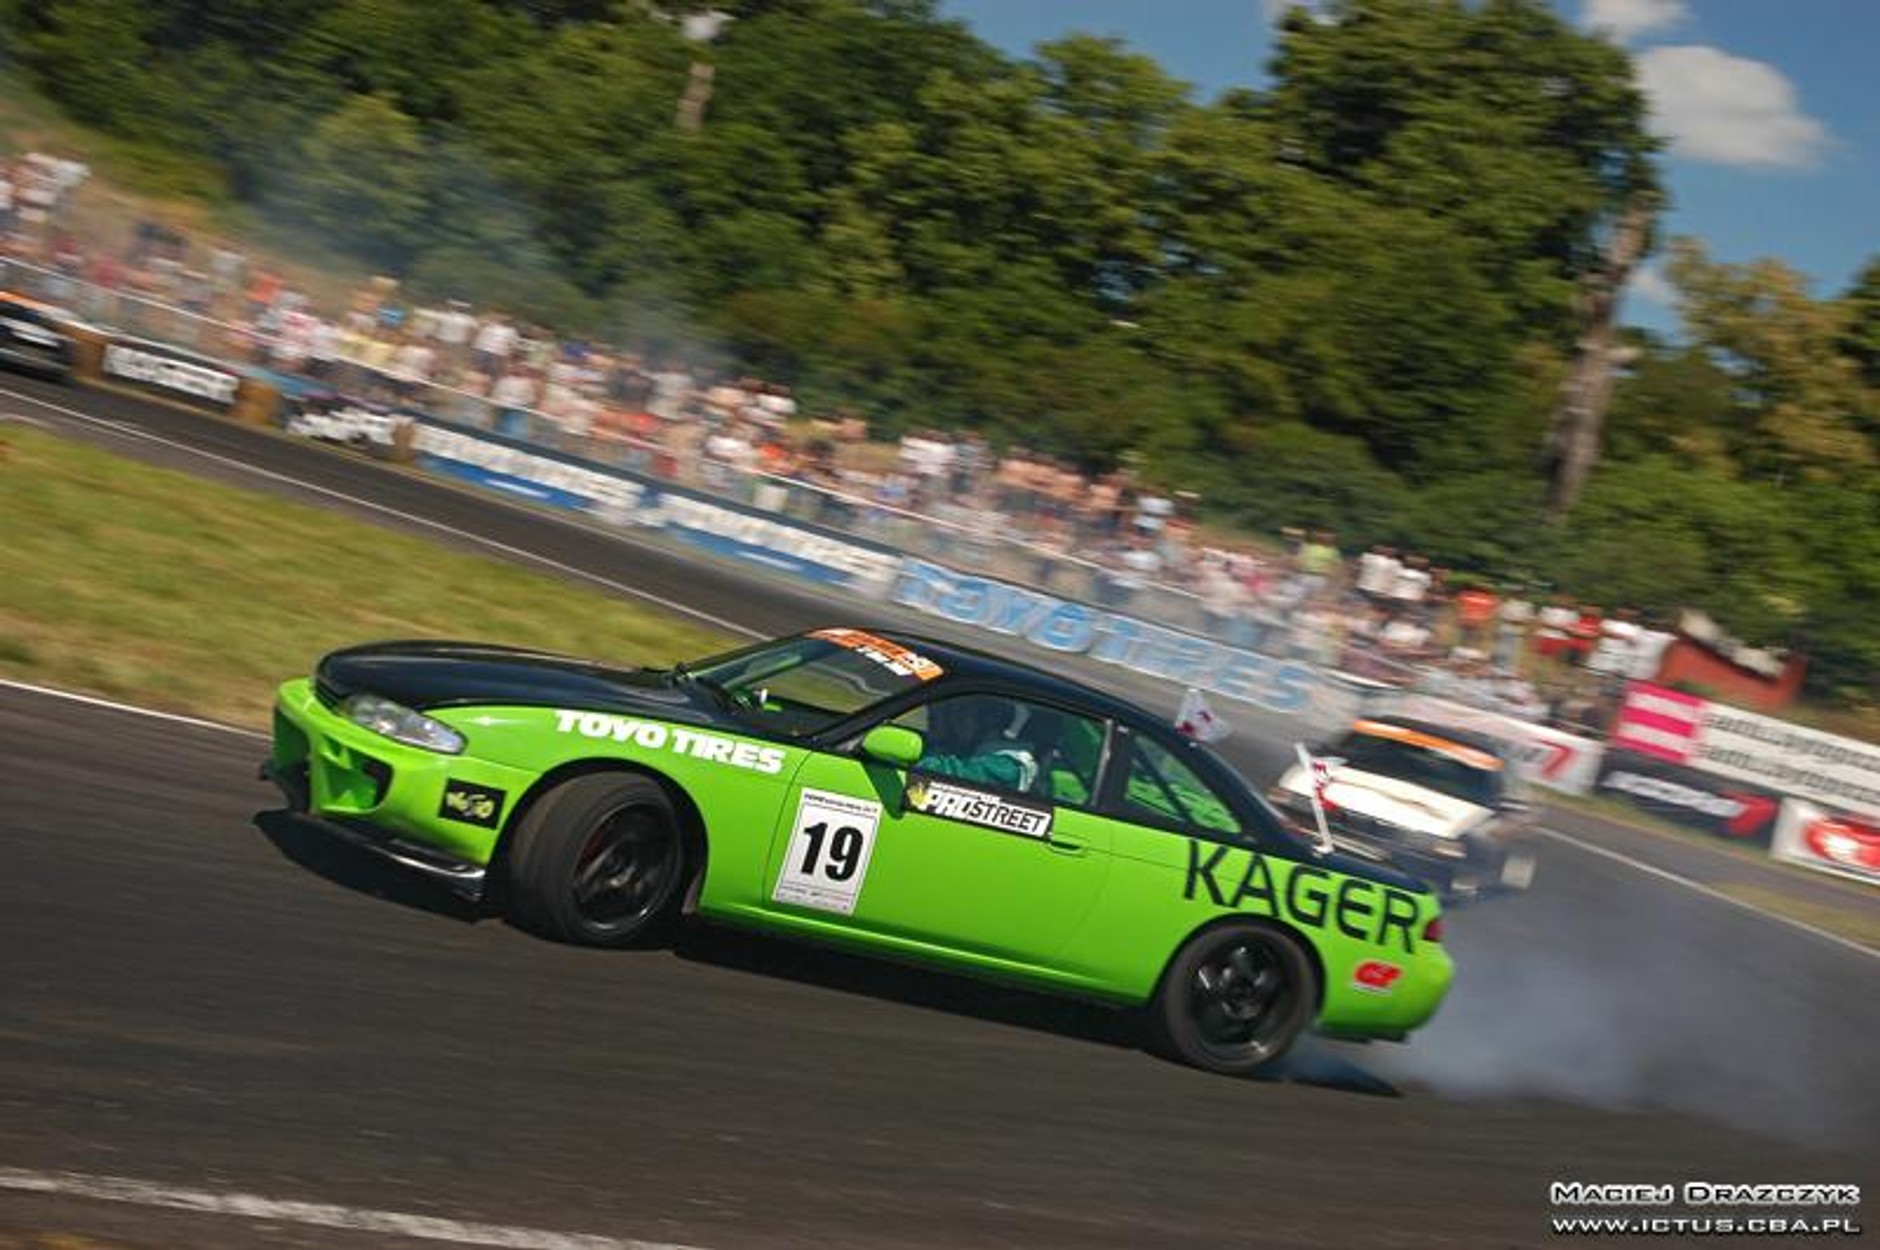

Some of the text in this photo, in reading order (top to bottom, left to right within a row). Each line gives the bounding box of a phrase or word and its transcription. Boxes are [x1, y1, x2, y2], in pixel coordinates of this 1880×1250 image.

[555, 709, 785, 774] TOYO TIRES
[800, 821, 864, 882] 19
[1183, 839, 1419, 955] KAGER
